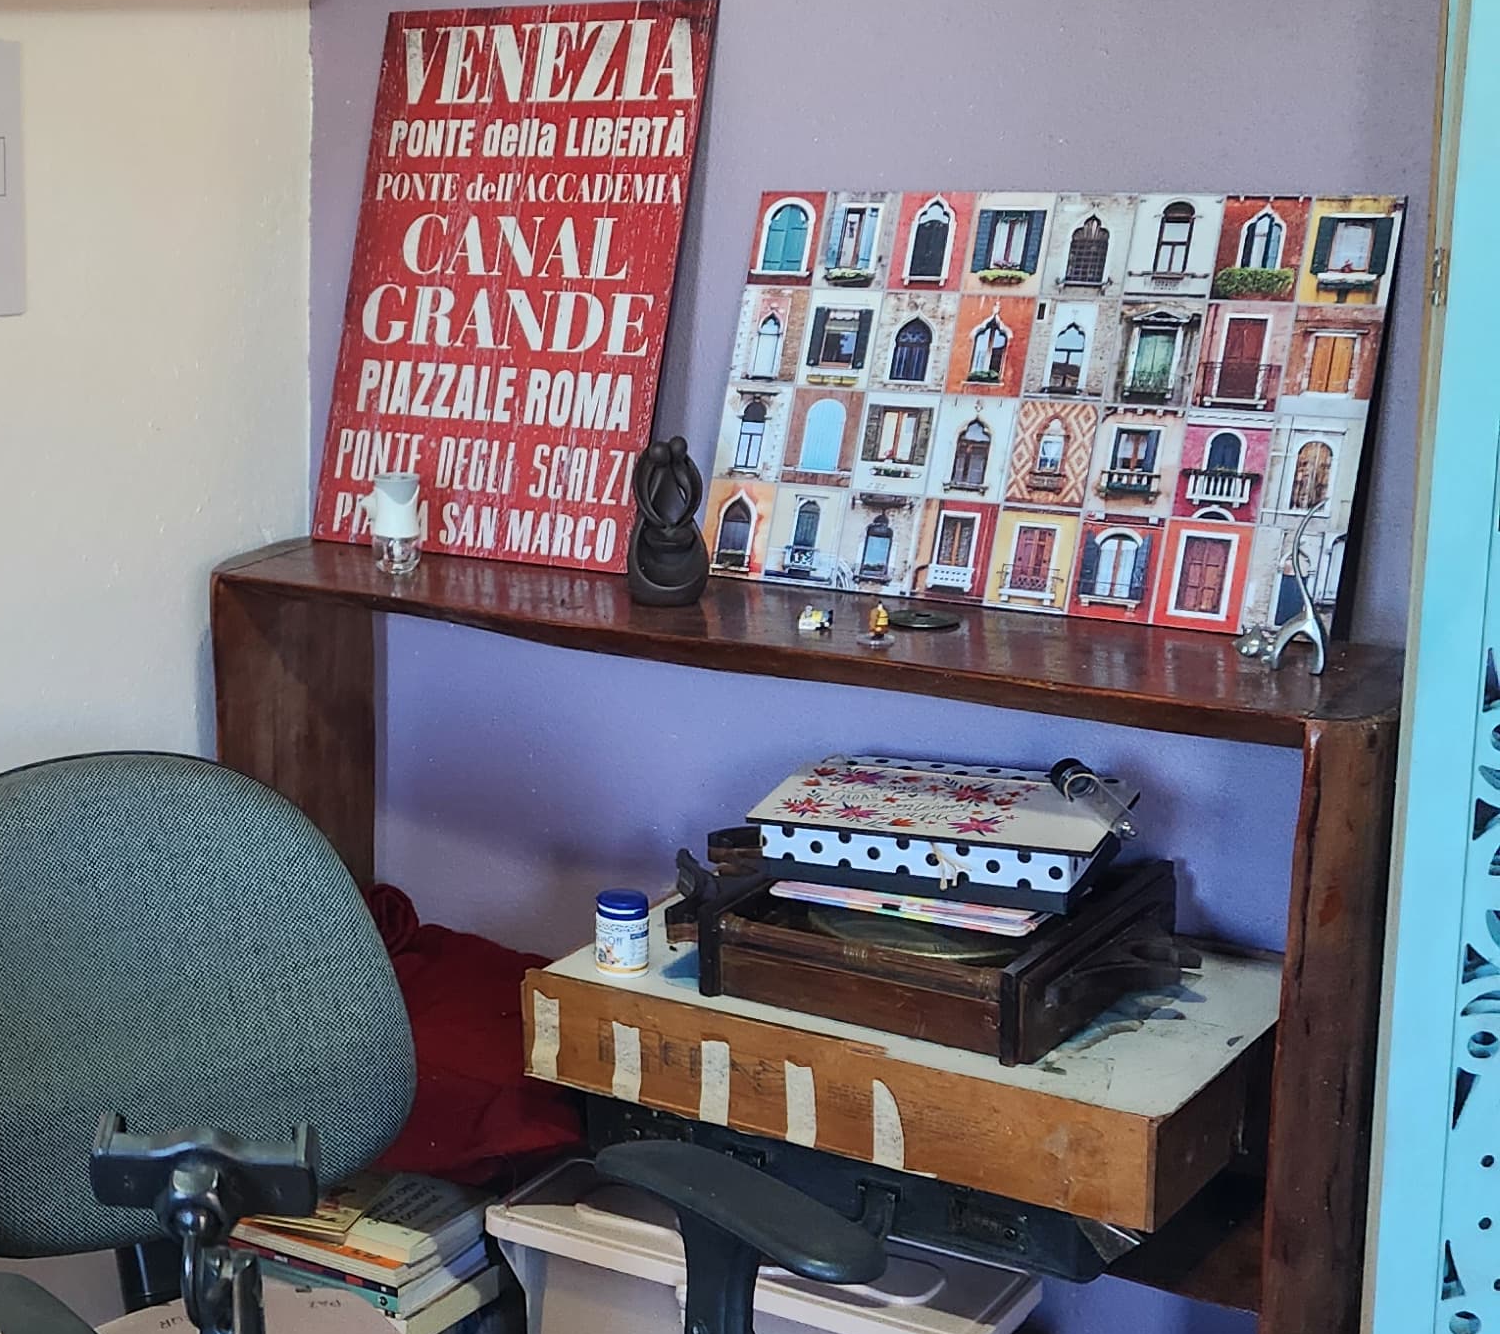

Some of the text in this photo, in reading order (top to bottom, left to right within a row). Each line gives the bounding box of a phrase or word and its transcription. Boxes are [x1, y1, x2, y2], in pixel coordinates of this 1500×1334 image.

[402, 18, 696, 106] VENEZIA
[388, 110, 685, 157] PONTE della LIBERTÀ
[375, 172, 682, 204] PONTE dell'ACCADEMIA
[402, 213, 627, 281] CANAL
[361, 283, 655, 357] GRANDE
[356, 360, 633, 432] PIAZZALE ROMA
[334, 428, 636, 506] PONTE DEGLI SCALZI
[439, 502, 502, 551] SAN
[503, 508, 616, 563] MARCO
